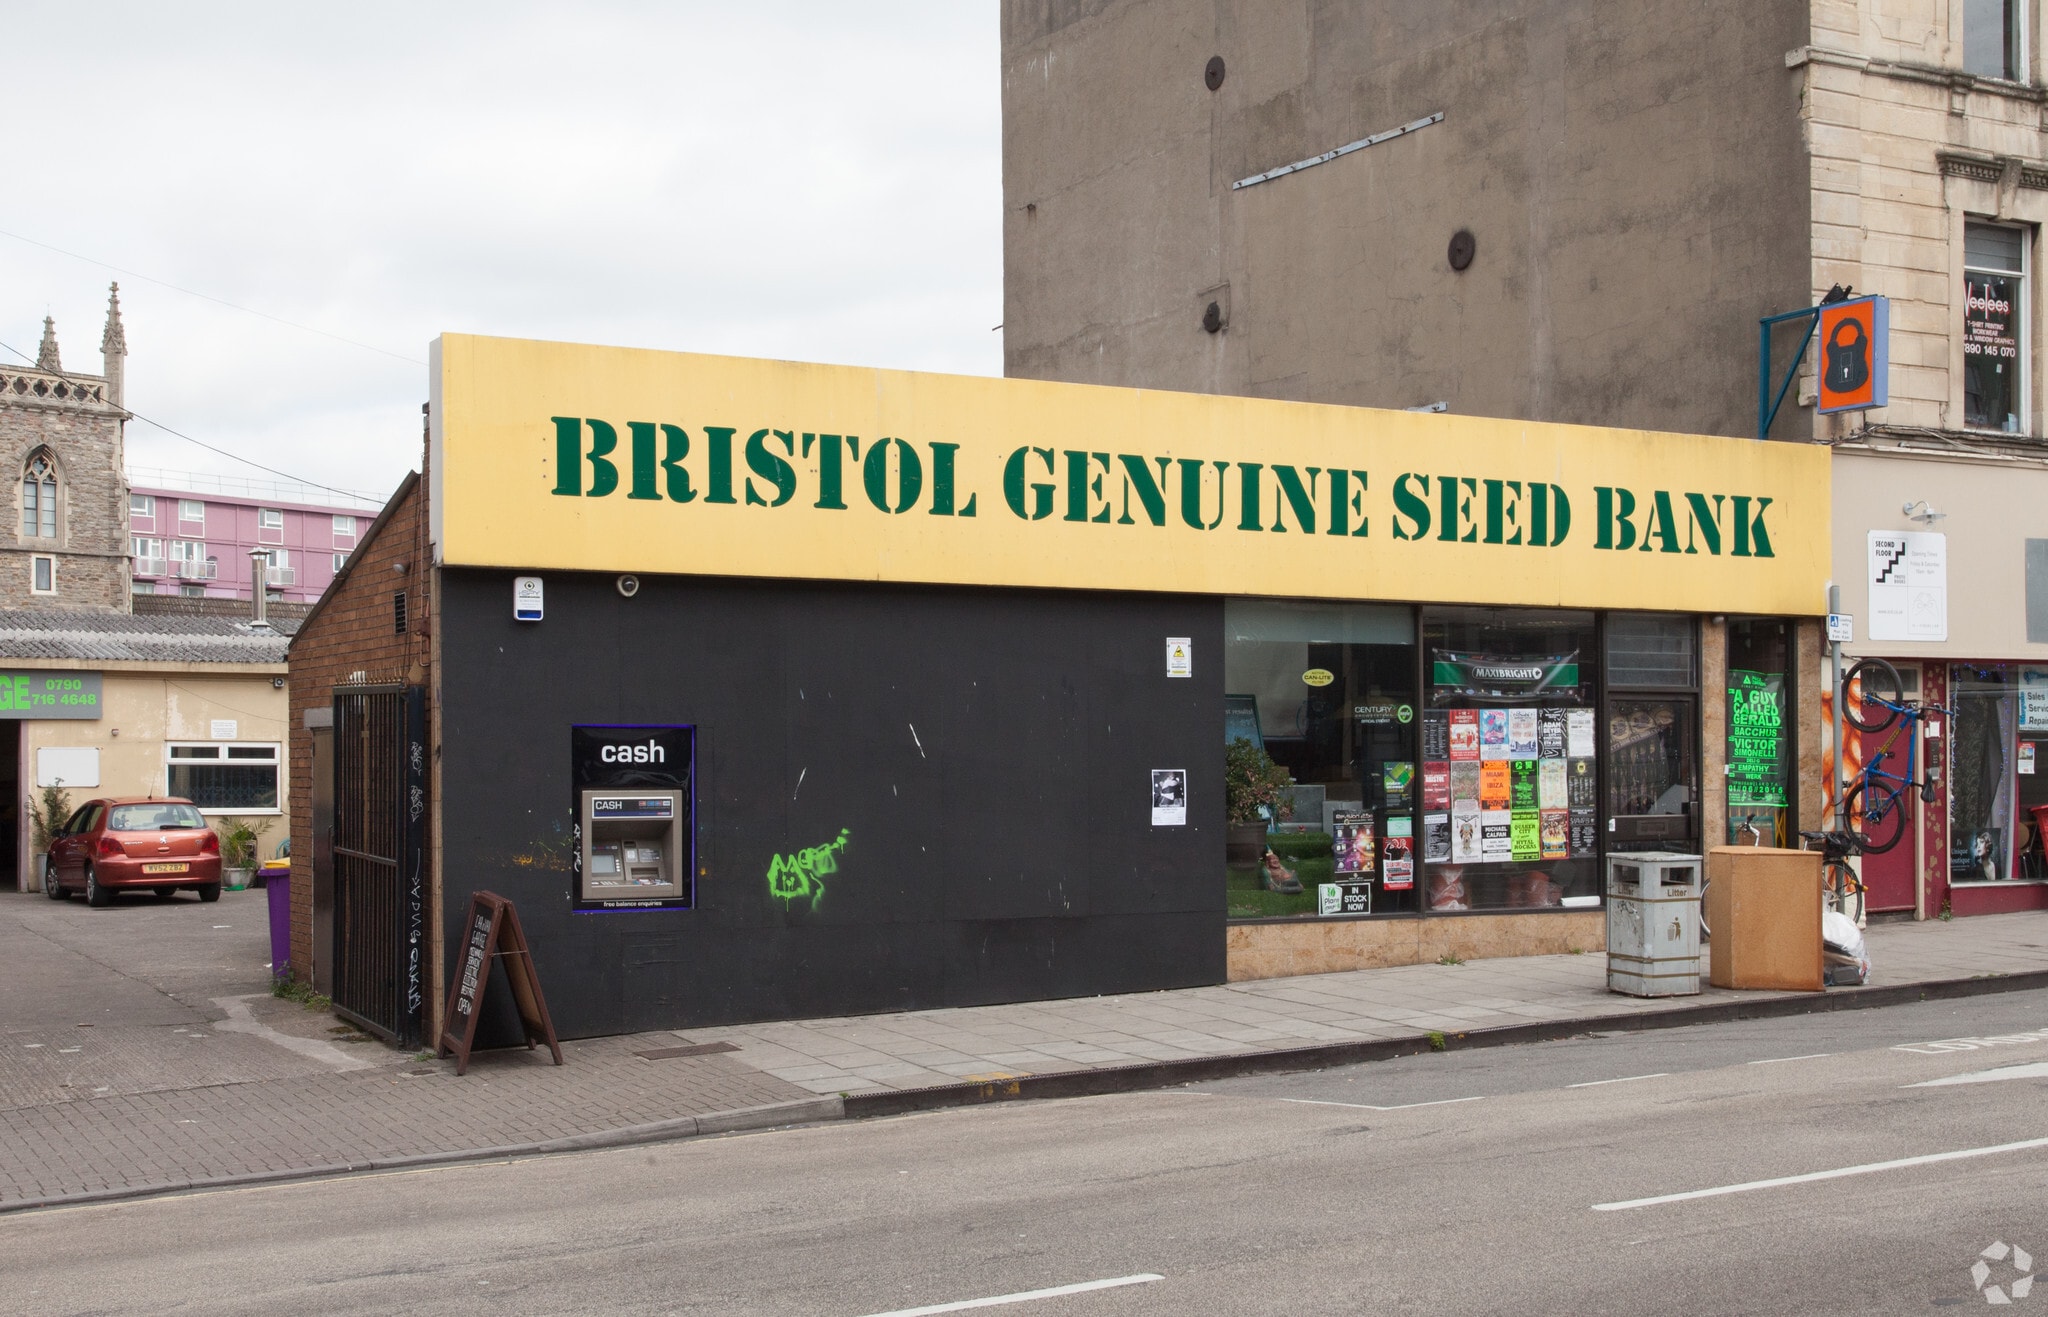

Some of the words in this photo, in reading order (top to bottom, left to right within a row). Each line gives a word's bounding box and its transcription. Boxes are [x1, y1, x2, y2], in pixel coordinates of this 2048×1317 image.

[1964, 343, 1980, 354] 890
[1984, 346, 1998, 356] 145
[2000, 347, 2016, 358] 070
[550, 415, 977, 518] BRISTOL
[1002, 445, 1368, 538] GENUINE
[1391, 472, 1572, 548] SEED
[1593, 486, 1775, 558] BANK
[1476, 668, 1533, 678] MAXIBRIGHT
[45, 679, 82, 690] 0790
[32, 694, 56, 704] 716
[60, 693, 97, 705] 4648
[1734, 689, 1744, 703] A
[1749, 690, 1778, 706] GUY
[2028, 692, 2046, 700] Sales
[1354, 706, 1393, 714] CENTURY
[1733, 702, 1779, 716] CALLED
[1733, 714, 1781, 727] GERALD
[1734, 726, 1778, 737] BACCHUS
[1734, 738, 1776, 750] VICTOR
[600, 739, 665, 764] cash
[1734, 748, 1776, 758] SIMONELLI
[595, 801, 622, 810] CASH
[1667, 888, 1687, 896] Litter
[1344, 894, 1368, 903] STOCK
[1347, 903, 1364, 911] NOW
[458, 997, 472, 1016] OPEN
